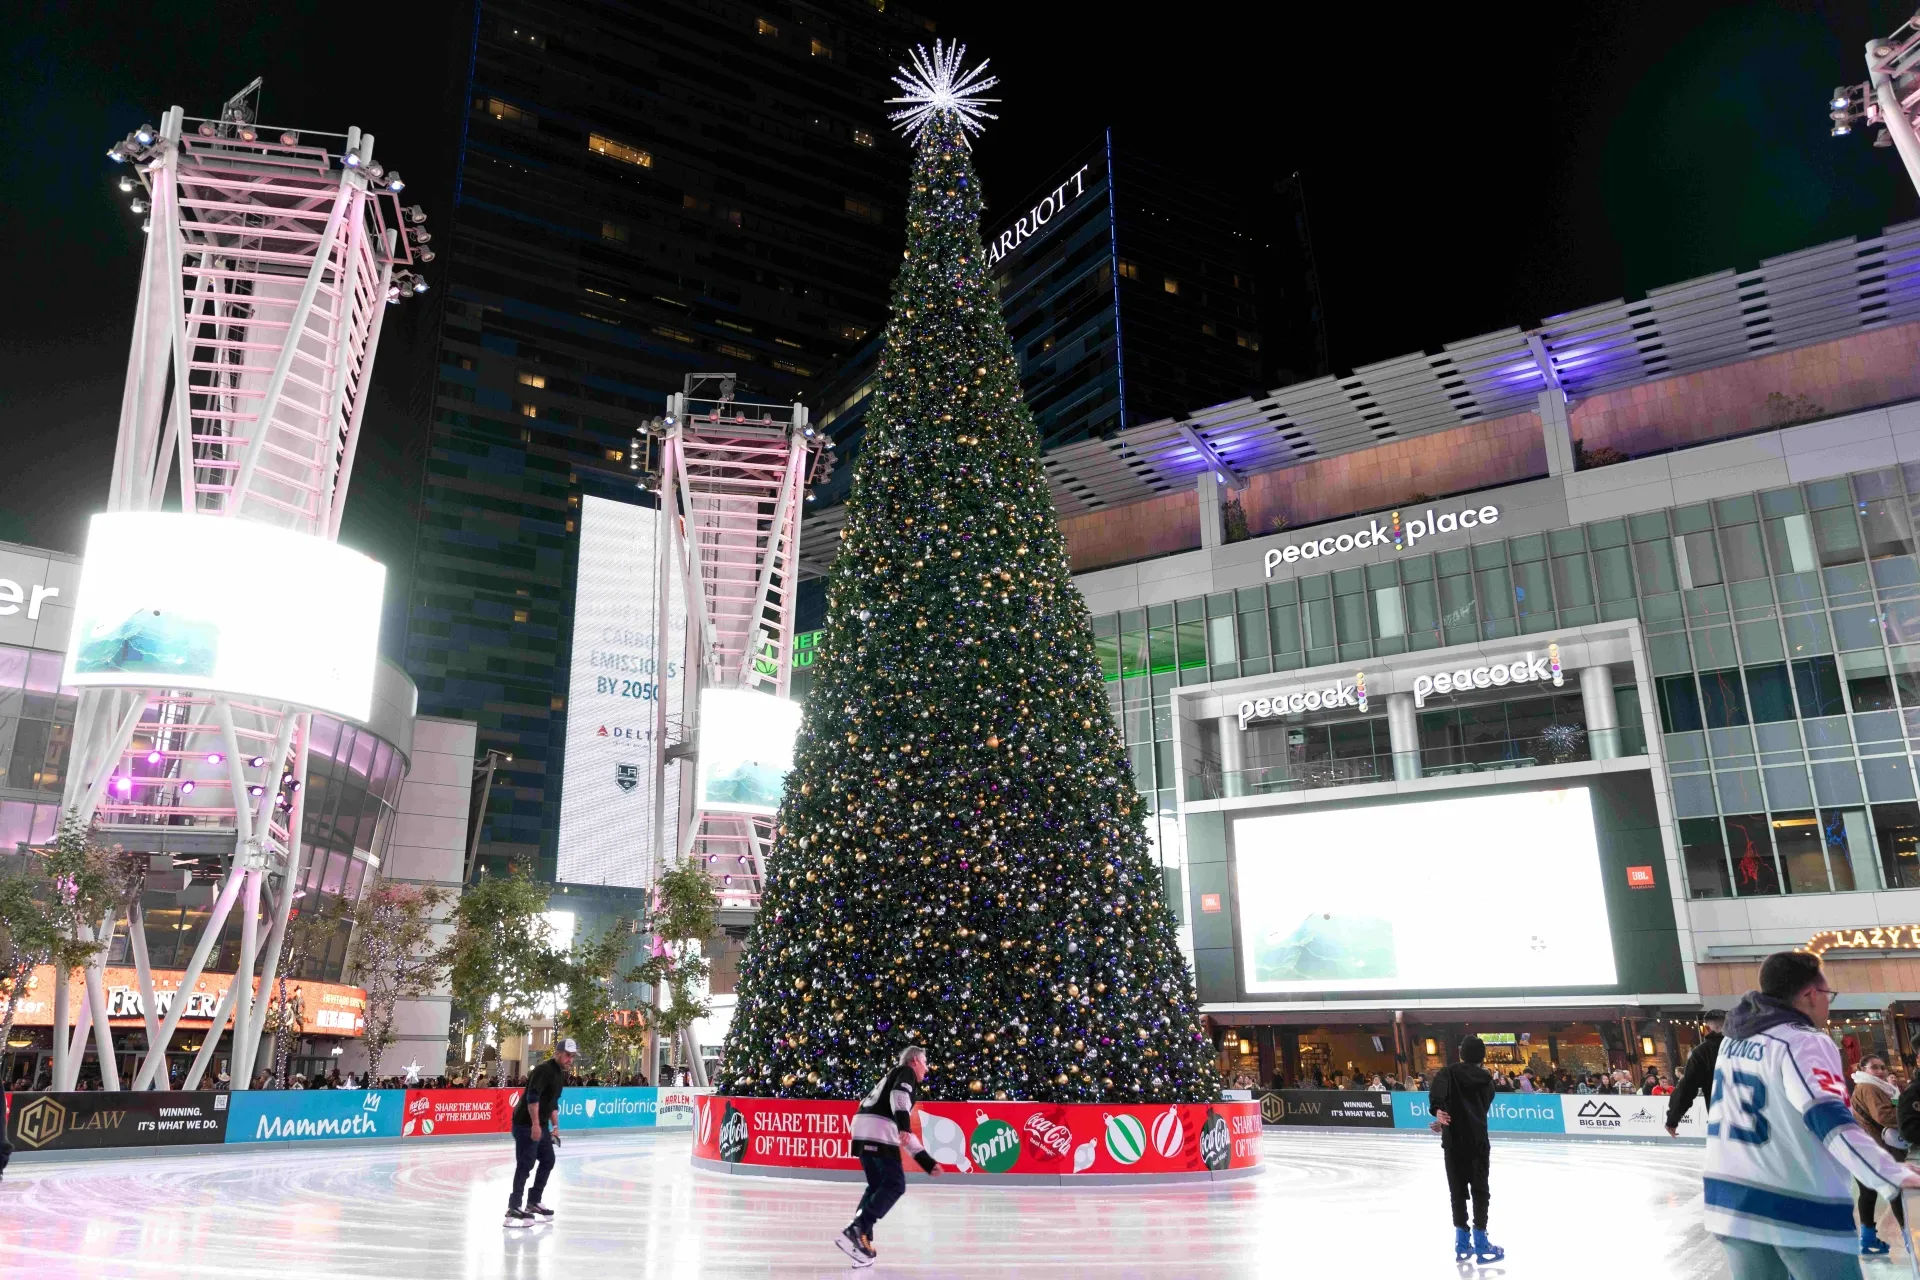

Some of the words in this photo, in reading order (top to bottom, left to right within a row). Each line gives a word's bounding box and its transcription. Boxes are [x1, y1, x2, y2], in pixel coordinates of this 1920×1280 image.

[981, 164, 1088, 269] ARRIOTT
[1264, 520, 1390, 578] peacock
[1405, 504, 1499, 547] place
[602, 626, 659, 649] CARBO
[590, 650, 677, 678] EMISSIOS
[791, 650, 813, 668] NU
[597, 675, 618, 694] BY
[1413, 651, 1551, 708] peacock
[1237, 679, 1358, 731] peacock
[613, 727, 657, 741] DELT
[1631, 871, 1649, 881] JBL
[1836, 929, 1901, 946] LAZY
[435, 1103, 458, 1112] SHARE
[459, 1103, 472, 1111] THE
[471, 1102, 493, 1111] MAGIC
[557, 1099, 583, 1116] lue
[598, 1098, 656, 1115] california
[665, 1095, 690, 1105] HARLEM
[1288, 1102, 1321, 1114] LAW
[1707, 1067, 1770, 1146] 23
[159, 1107, 202, 1117] WINNING.
[435, 1113, 446, 1122] OF
[446, 1113, 459, 1121] THE
[460, 1111, 492, 1121] HOLIDAYS
[660, 1105, 694, 1114] GLOBETROTTERS
[1487, 1103, 1555, 1120] lifornia
[69, 1110, 126, 1130] LAW
[138, 1121, 156, 1131] IT'S
[158, 1121, 185, 1130] WHAT
[186, 1120, 201, 1129] WE
[203, 1120, 219, 1129] DO.
[256, 1112, 377, 1139] Mammoth
[754, 1111, 802, 1133] SHARE
[805, 1113, 839, 1134] THE
[755, 1135, 775, 1155] OF
[776, 1137, 809, 1157] THE
[811, 1138, 860, 1159] HOLI
[971, 1127, 1019, 1166] Sprite
[1235, 1139, 1247, 1157] OF
